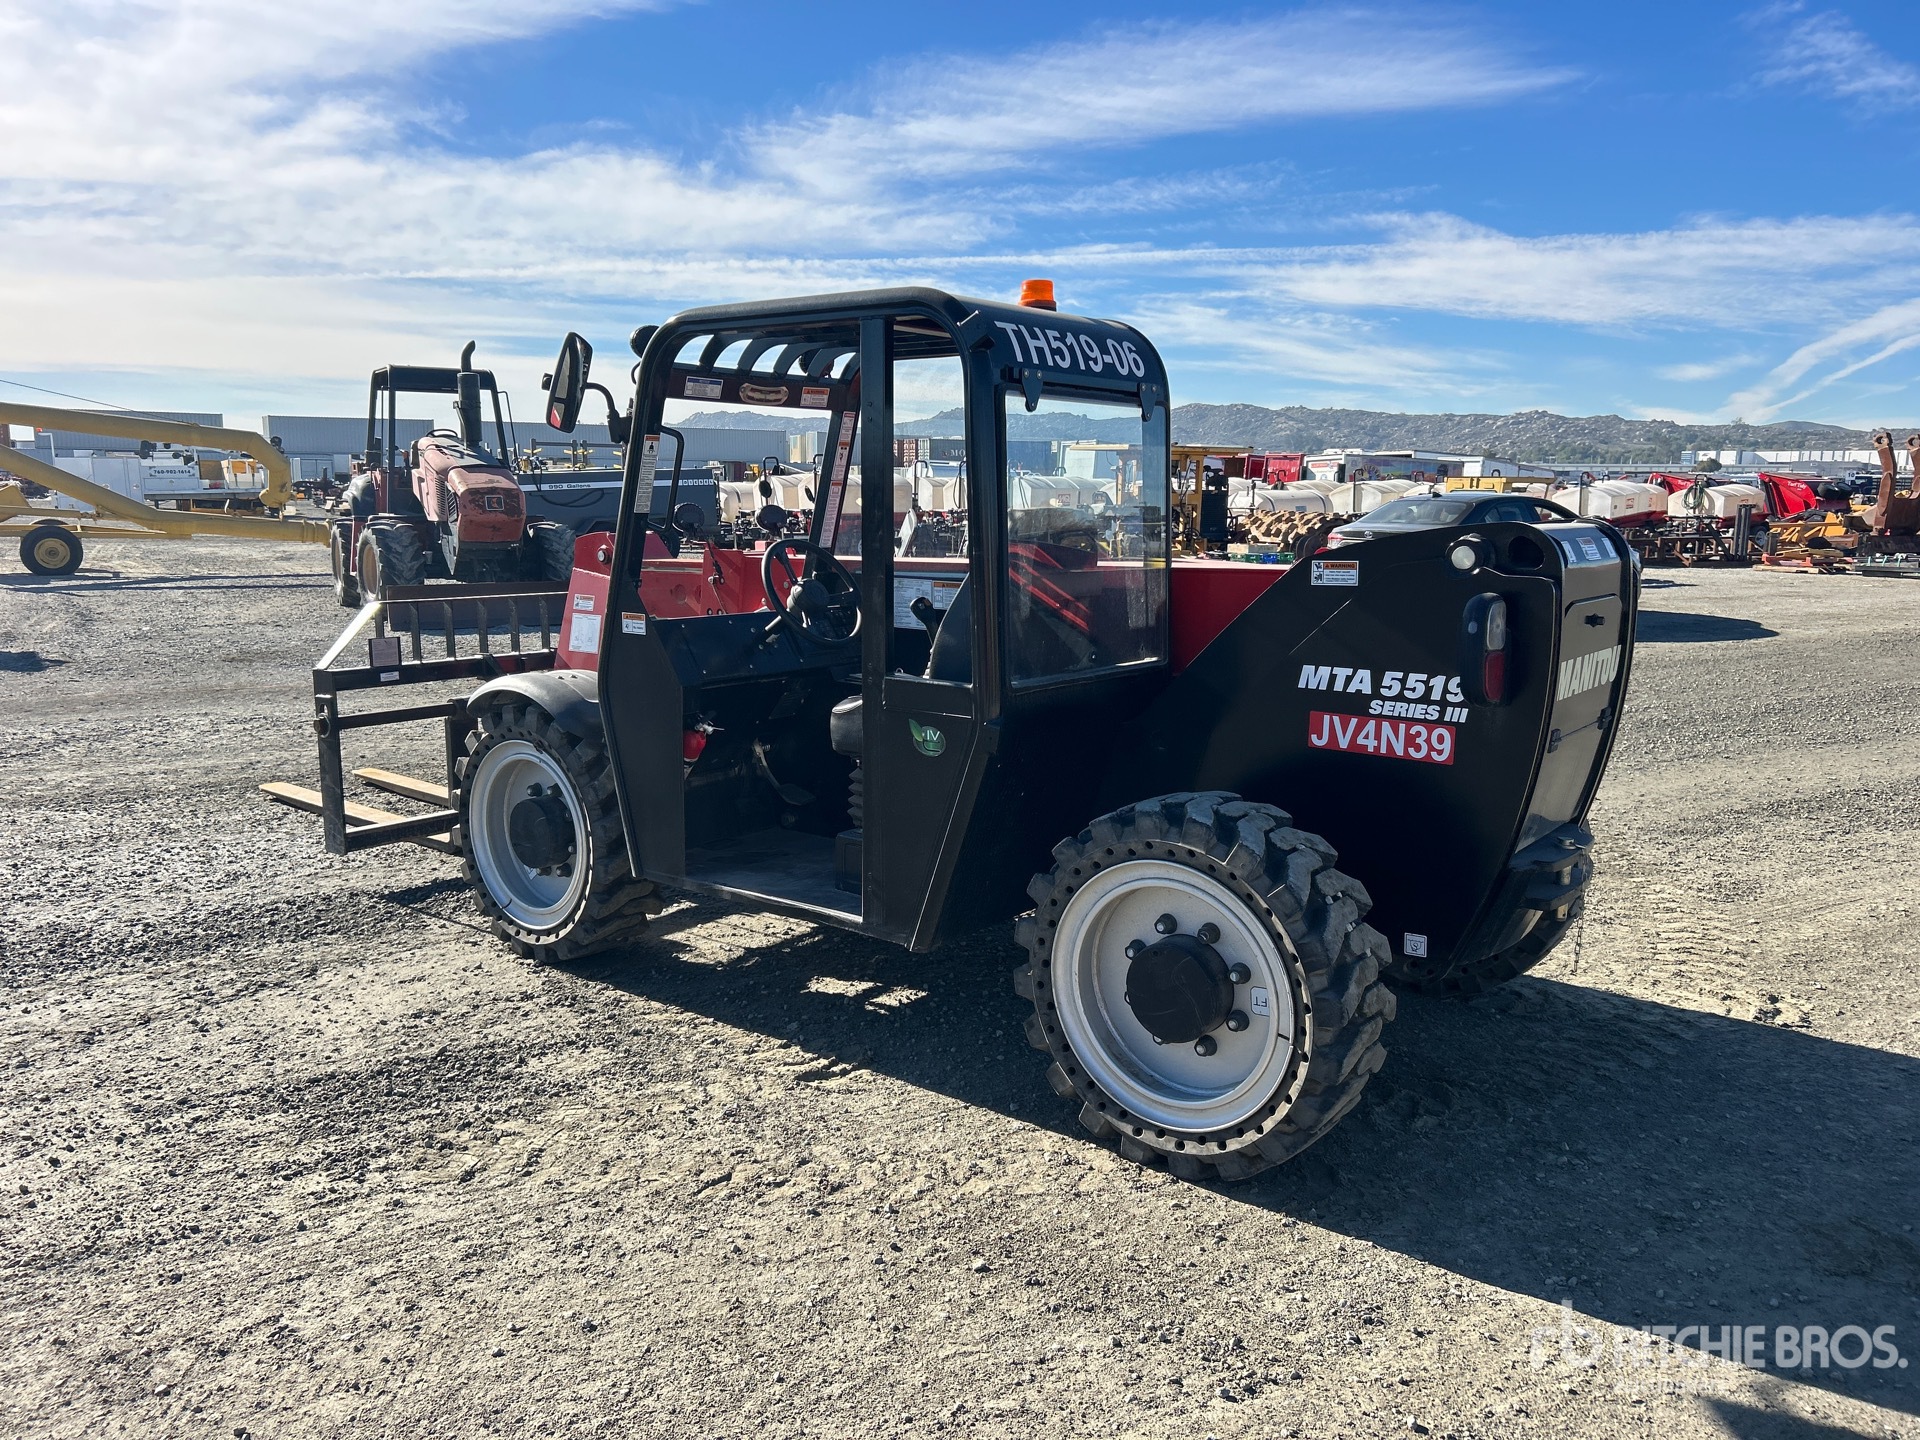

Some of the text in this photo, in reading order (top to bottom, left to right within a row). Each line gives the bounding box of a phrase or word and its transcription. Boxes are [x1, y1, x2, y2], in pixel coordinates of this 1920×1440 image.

[994, 320, 1145, 378] TH519-06
[1298, 664, 1465, 703] MTA 5519
[1556, 645, 1622, 701] MANITOU
[1368, 699, 1469, 723] SERIES III
[927, 729, 941, 741] IV
[1310, 714, 1452, 762] JV4N39
